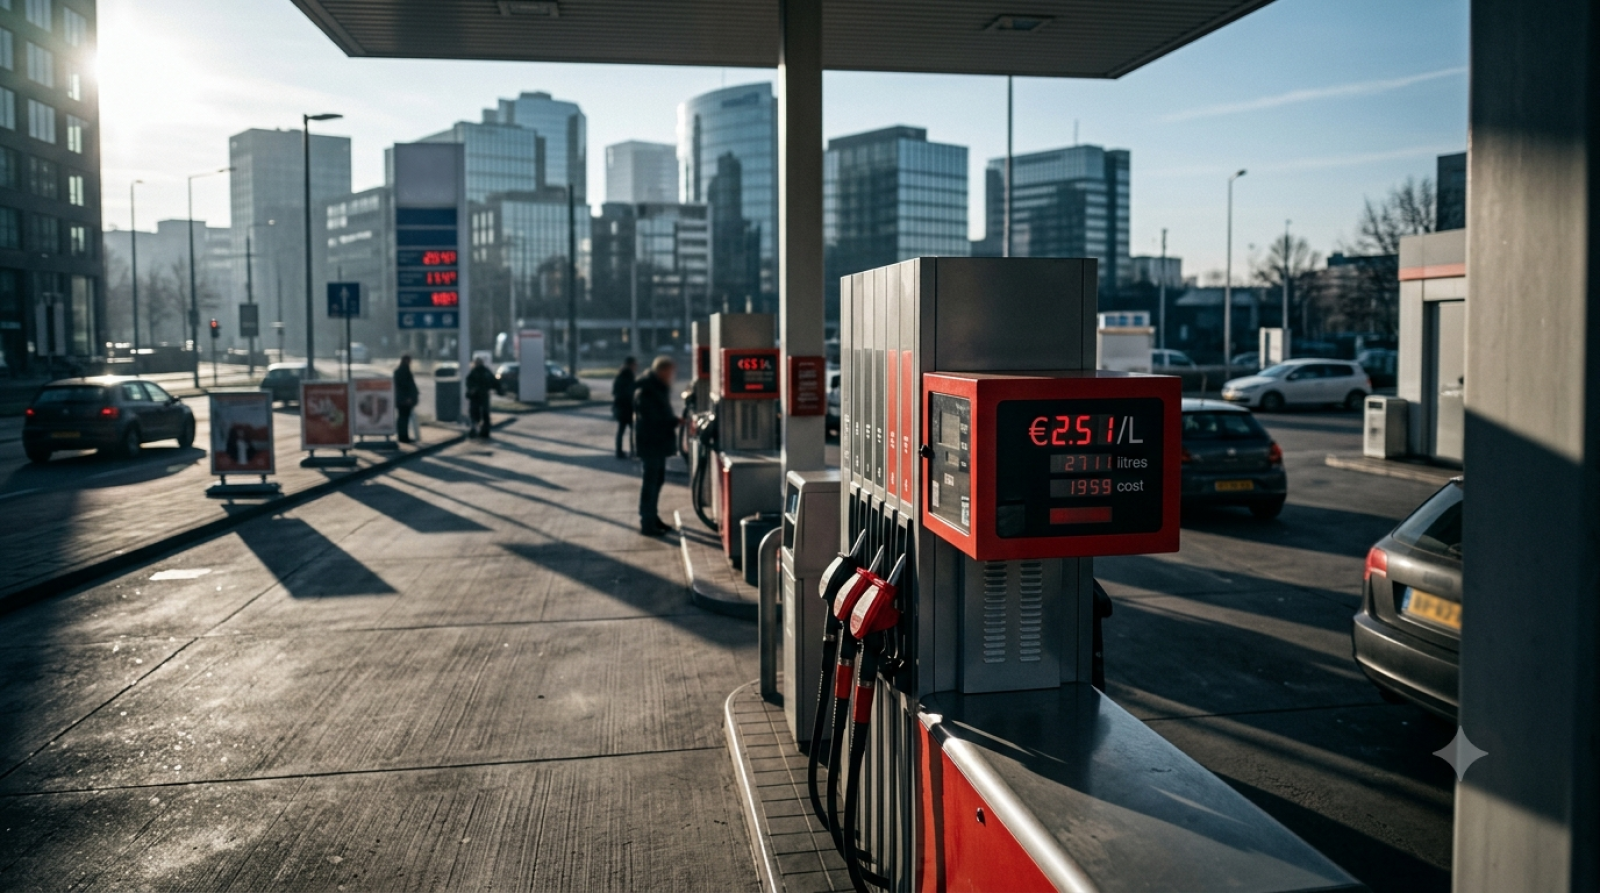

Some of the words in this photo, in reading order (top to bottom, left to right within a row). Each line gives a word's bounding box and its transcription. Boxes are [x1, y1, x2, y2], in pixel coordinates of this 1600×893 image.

[1064, 456, 1112, 472] 2711
[1070, 479, 1112, 495] 1959
[1116, 480, 1144, 492] cost
